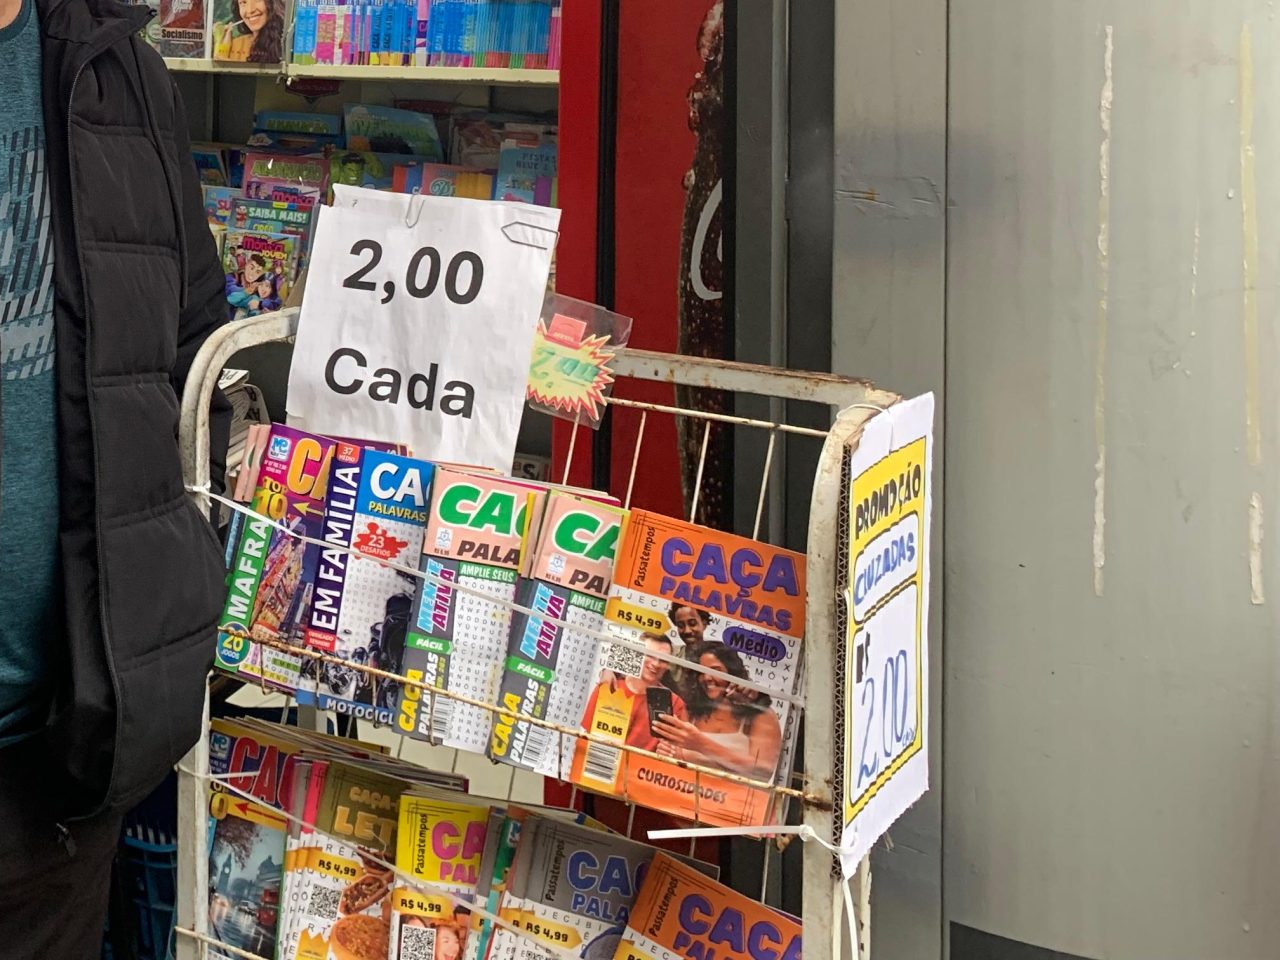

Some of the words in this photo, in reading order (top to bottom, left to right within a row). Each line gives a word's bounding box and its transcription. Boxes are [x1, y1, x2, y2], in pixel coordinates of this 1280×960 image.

[161, 29, 203, 41] Socialismo
[248, 207, 277, 220] SAIBA
[278, 210, 308, 224] MAIS!
[342, 239, 485, 305] 2,00
[324, 347, 476, 419] Cada
[369, 461, 431, 507] CA
[255, 486, 289, 521] 10
[368, 500, 427, 522] PALAVRAS
[319, 466, 361, 581] FAMÍLIA
[360, 545, 391, 558] DESAFIOS
[368, 534, 385, 548] 23
[226, 520, 271, 622] MAFRA
[634, 526, 657, 588] Passatempos
[660, 536, 801, 598] CAÇA
[461, 564, 491, 579] AMPLIE
[491, 569, 515, 583] SEUS
[311, 583, 342, 631] EM
[570, 593, 605, 612] AMPLIE
[659, 576, 793, 632] PALAVRAS
[616, 609, 633, 622] R$
[634, 615, 663, 631] 4,99
[415, 637, 445, 652] FÁCIL
[728, 630, 779, 659] Médio
[516, 662, 546, 679] FÁCIL
[596, 720, 624, 737] ED.05
[636, 767, 728, 804] CURIOSIDADES
[415, 813, 429, 875] Passatempos
[317, 858, 332, 870] R$
[333, 861, 357, 878] 4,99
[544, 839, 567, 902] Passatempos
[400, 898, 415, 911] R$
[416, 900, 443, 914] 4,99
[648, 877, 679, 938] Passatempos
[525, 921, 541, 935] R$
[543, 926, 569, 943] 4,99
